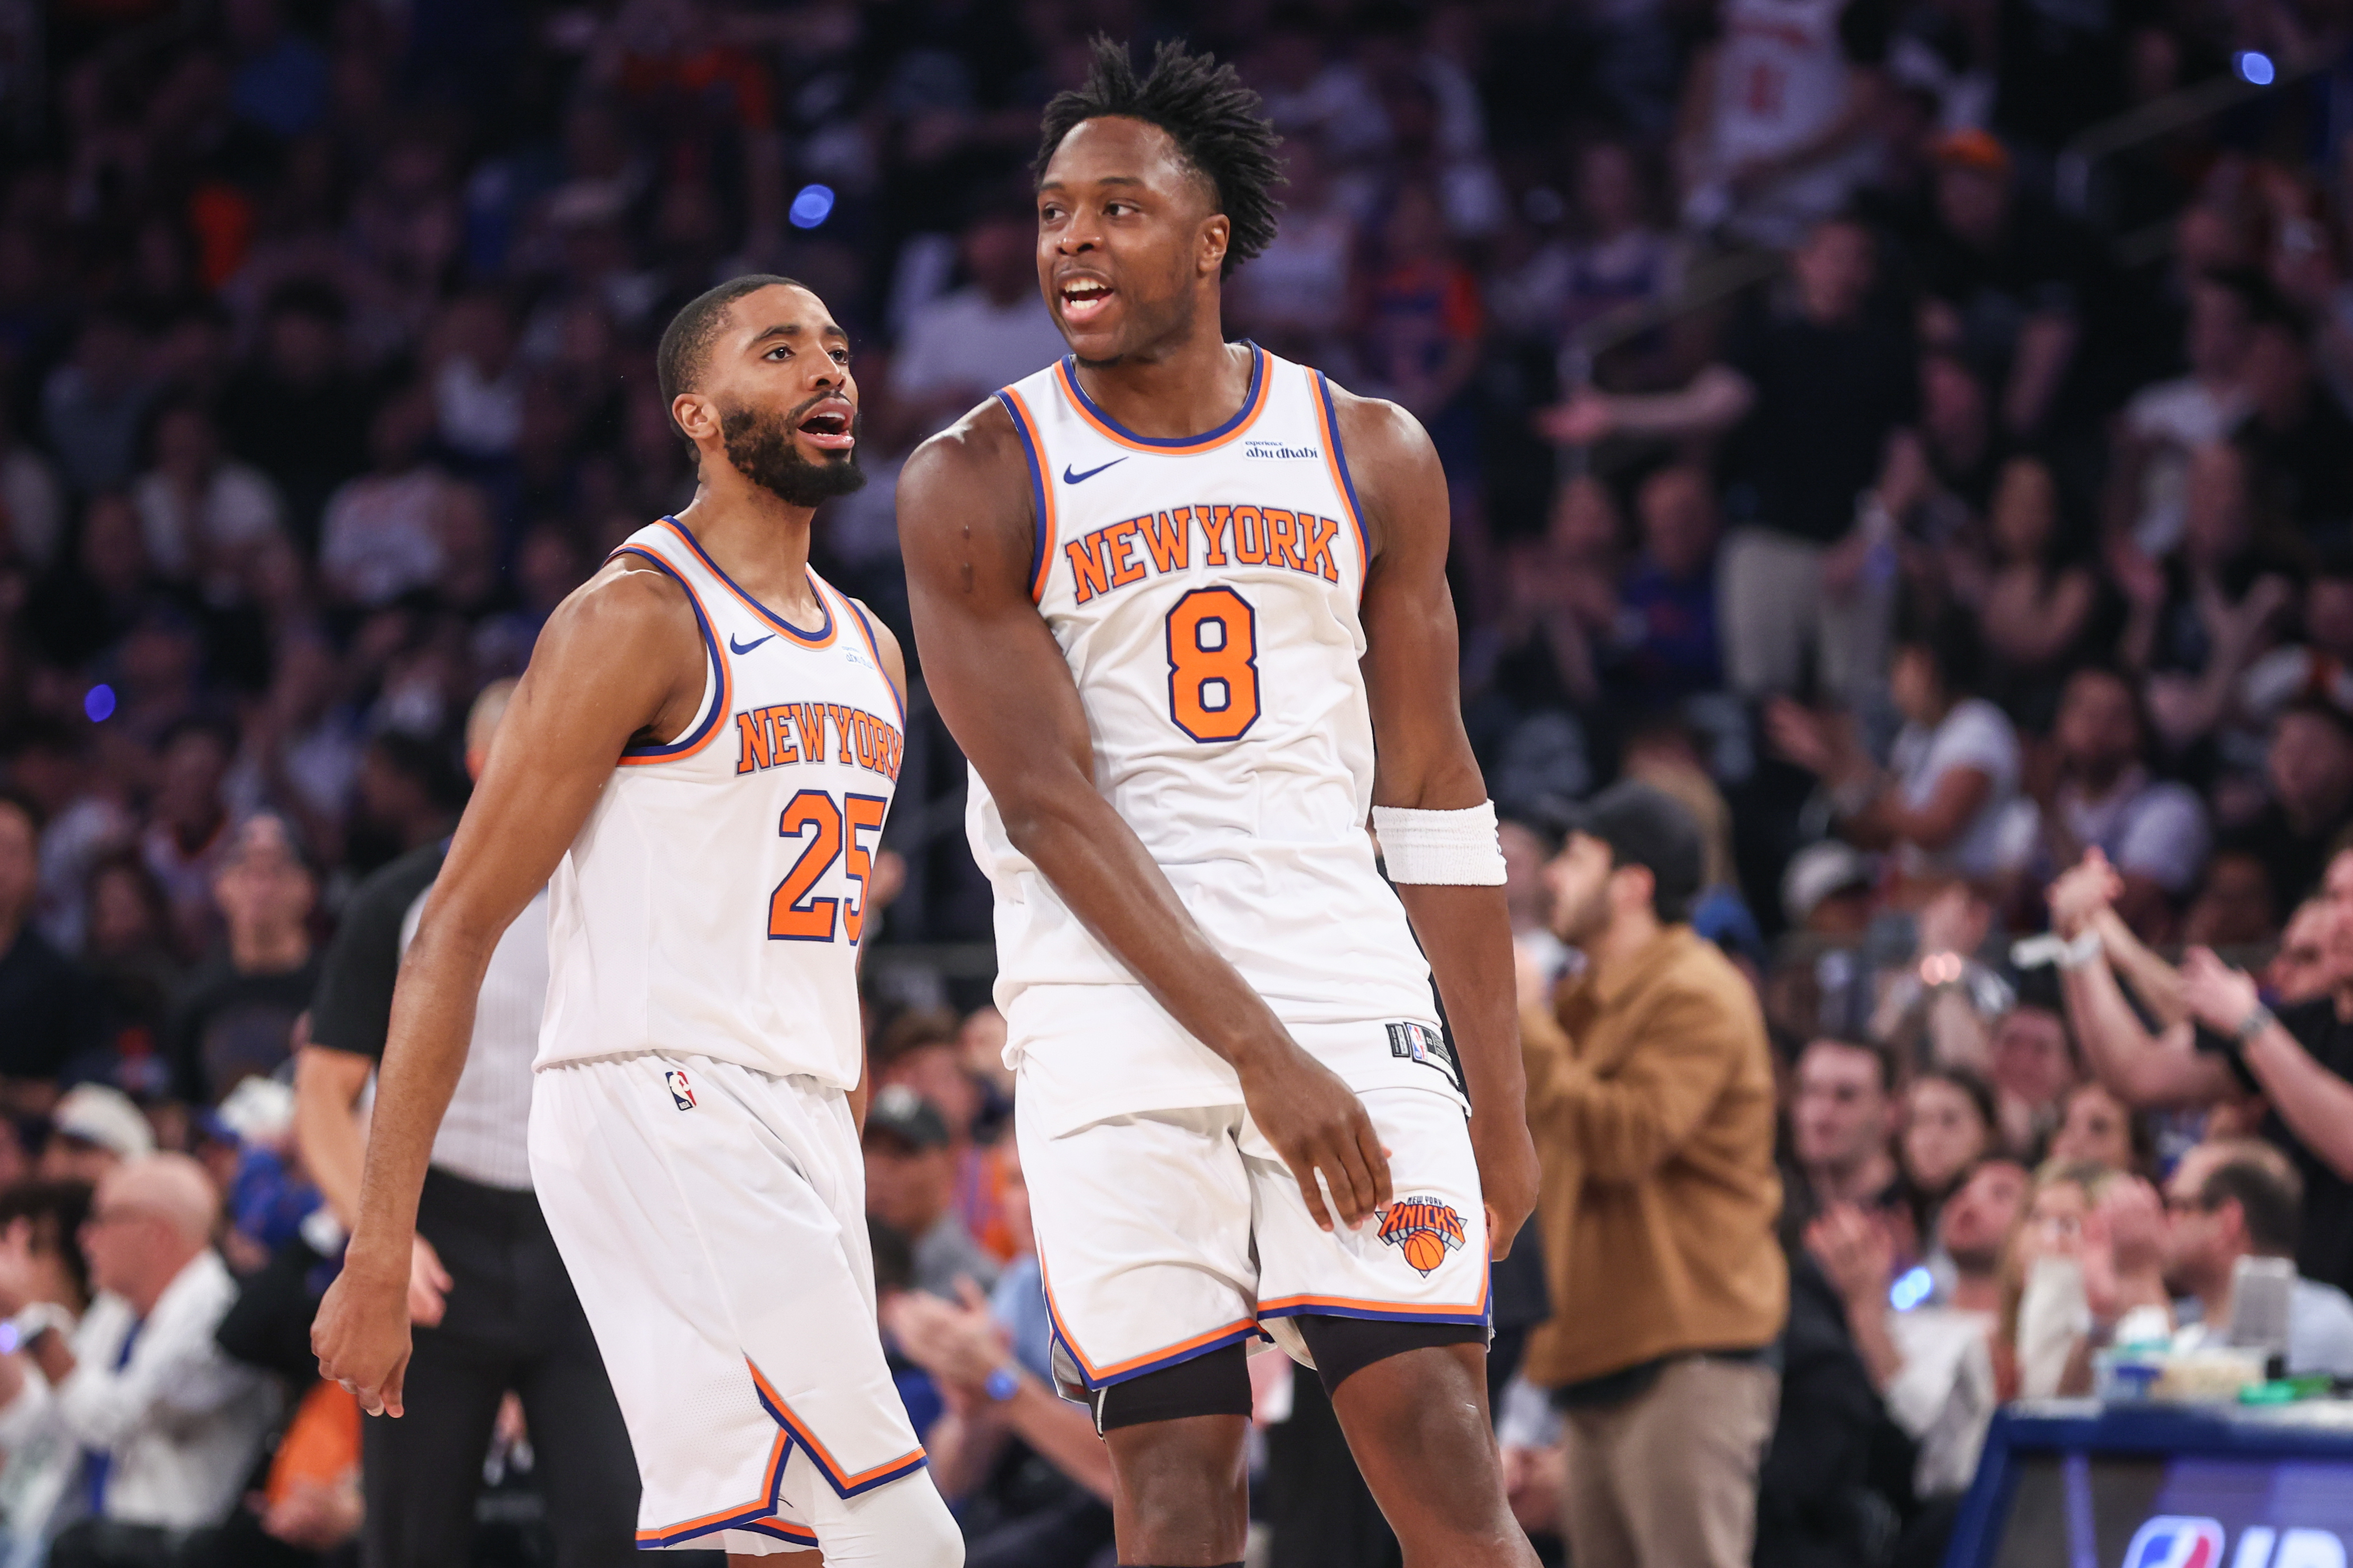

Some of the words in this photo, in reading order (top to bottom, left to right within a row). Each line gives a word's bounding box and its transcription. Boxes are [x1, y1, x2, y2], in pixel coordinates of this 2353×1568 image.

[1246, 447, 1274, 458] abu
[1276, 447, 1318, 458] dhabi
[1065, 506, 1191, 604] NEW
[1193, 505, 1338, 586] YORK
[1166, 586, 1261, 743] 8
[737, 703, 828, 775] NEW
[828, 708, 903, 785] YORK
[768, 789, 888, 946] 25
[1378, 1201, 1465, 1244] KNICKS
[1407, 1195, 1423, 1204] NEW
[1425, 1196, 1443, 1207] YORK
